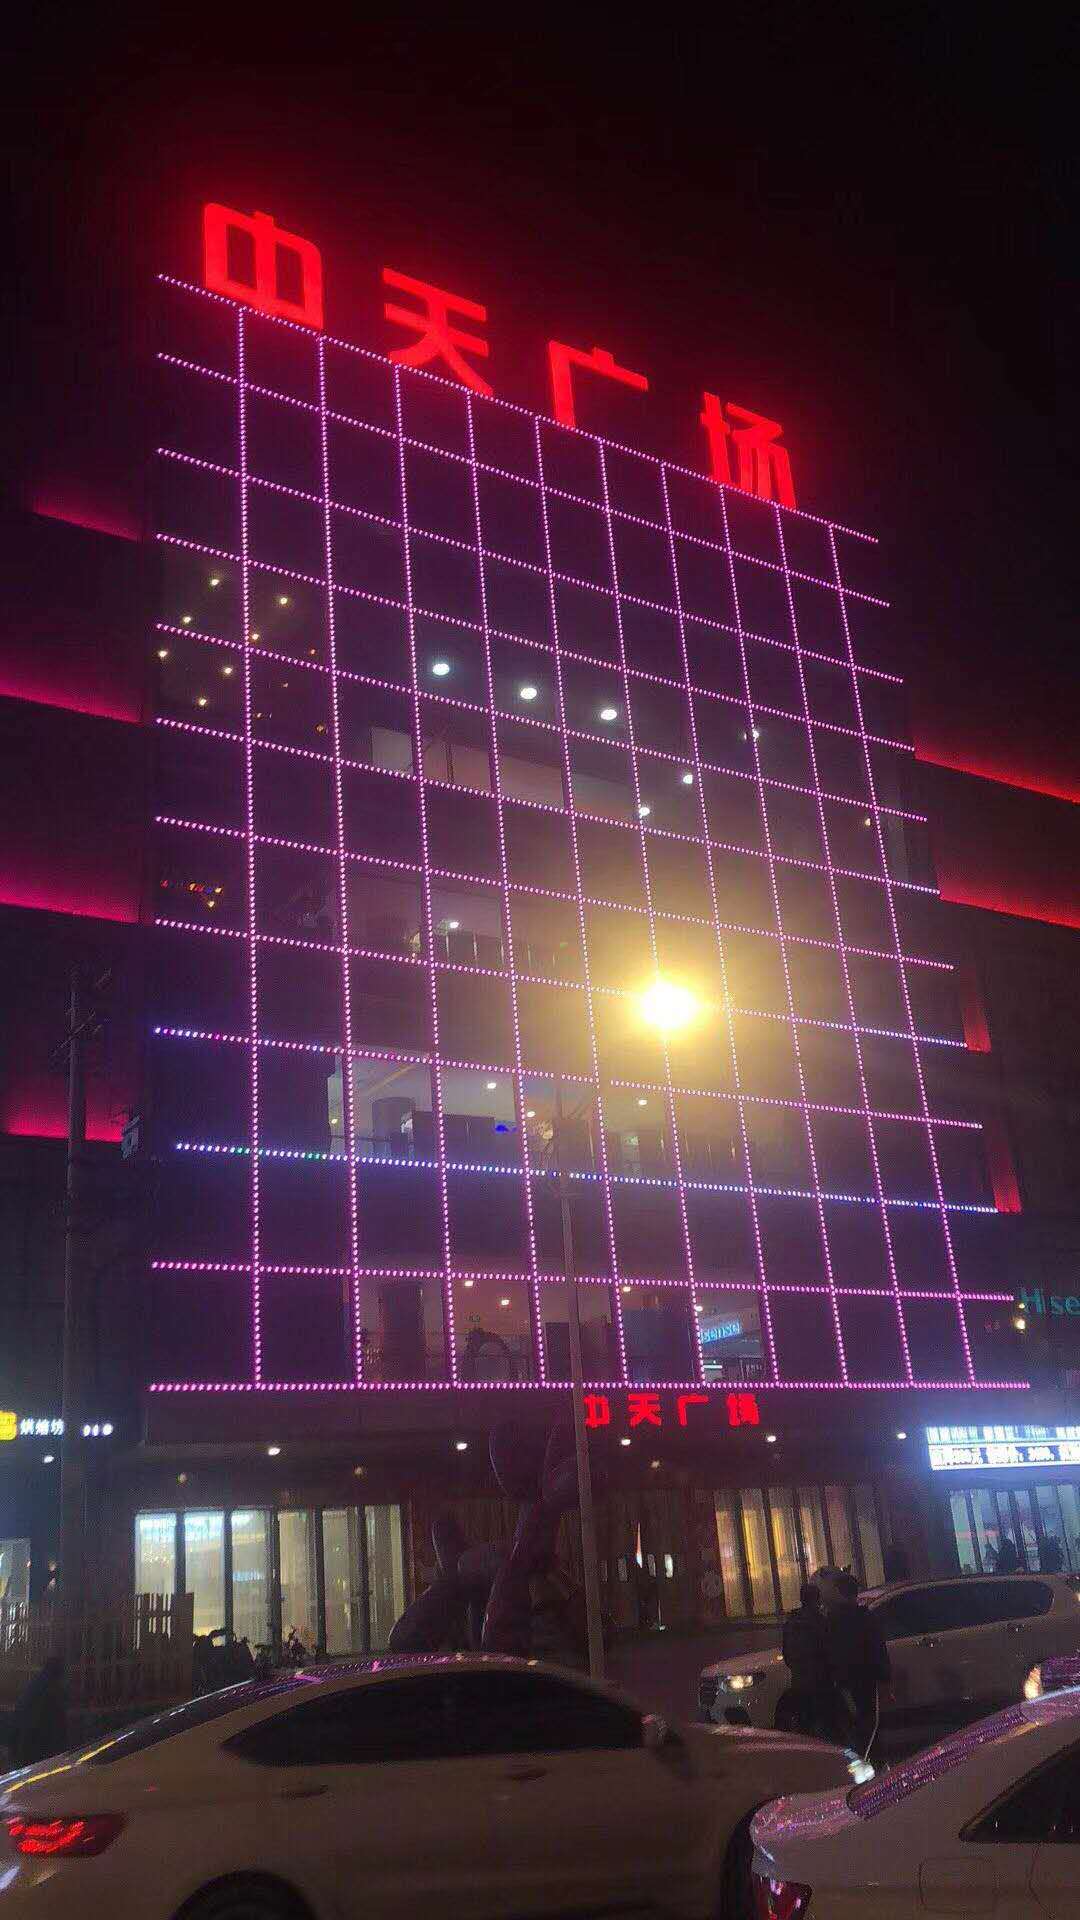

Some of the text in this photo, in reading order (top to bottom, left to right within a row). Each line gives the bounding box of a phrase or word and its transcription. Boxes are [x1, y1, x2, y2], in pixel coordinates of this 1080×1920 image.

[203, 203, 797, 511] 中天广场
[583, 1392, 761, 1428] 中天广场
